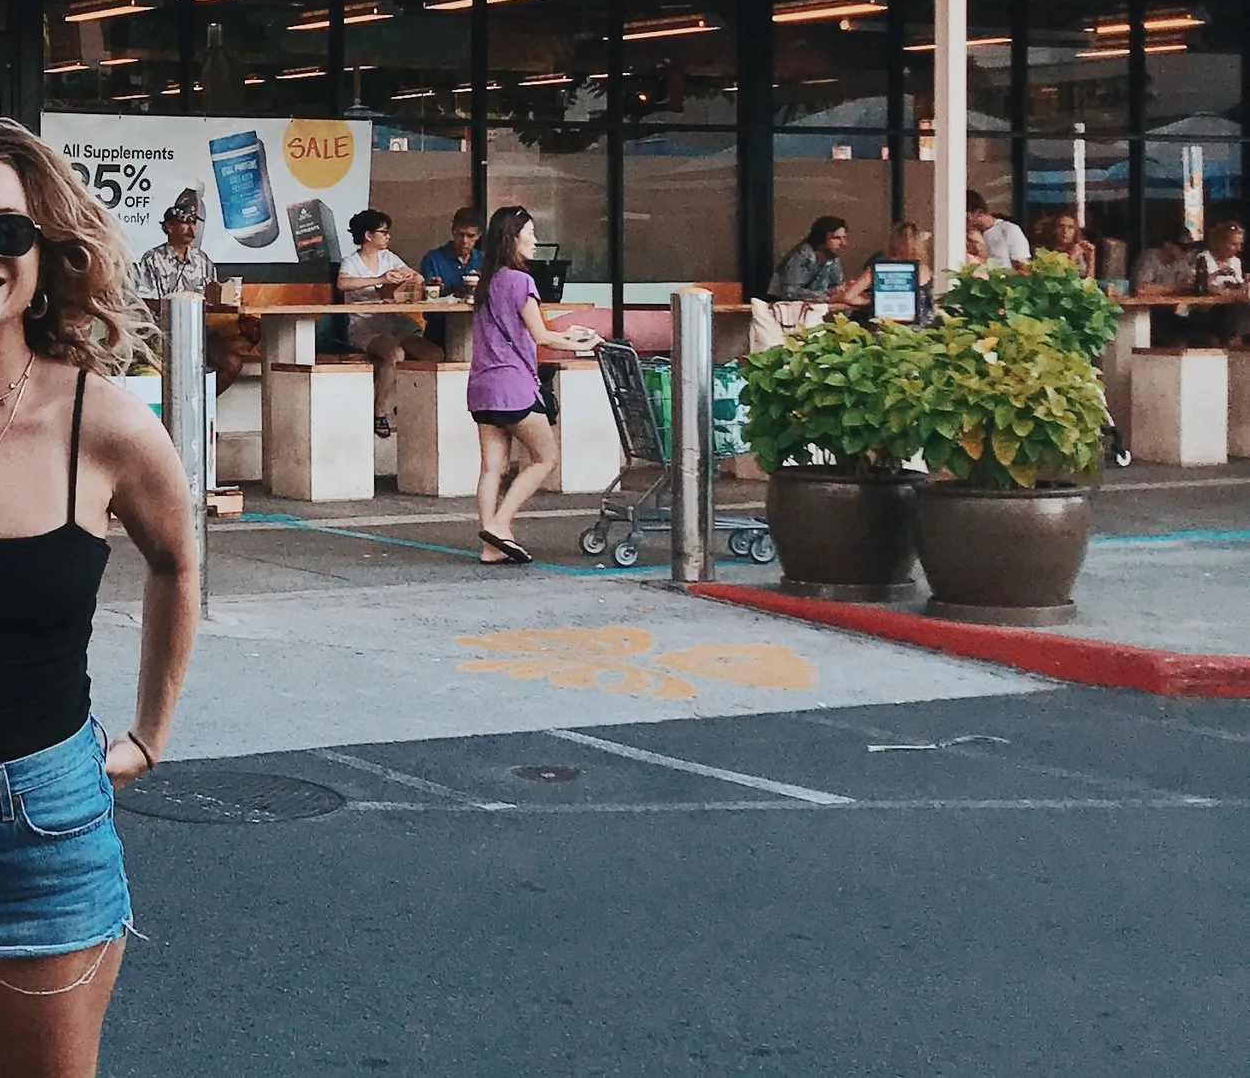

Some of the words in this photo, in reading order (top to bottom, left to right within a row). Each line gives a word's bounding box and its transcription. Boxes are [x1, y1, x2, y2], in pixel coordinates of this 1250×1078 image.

[63, 144, 80, 158] All
[83, 144, 175, 162] Supplements
[287, 135, 350, 160] SALE
[124, 196, 151, 208] OFF
